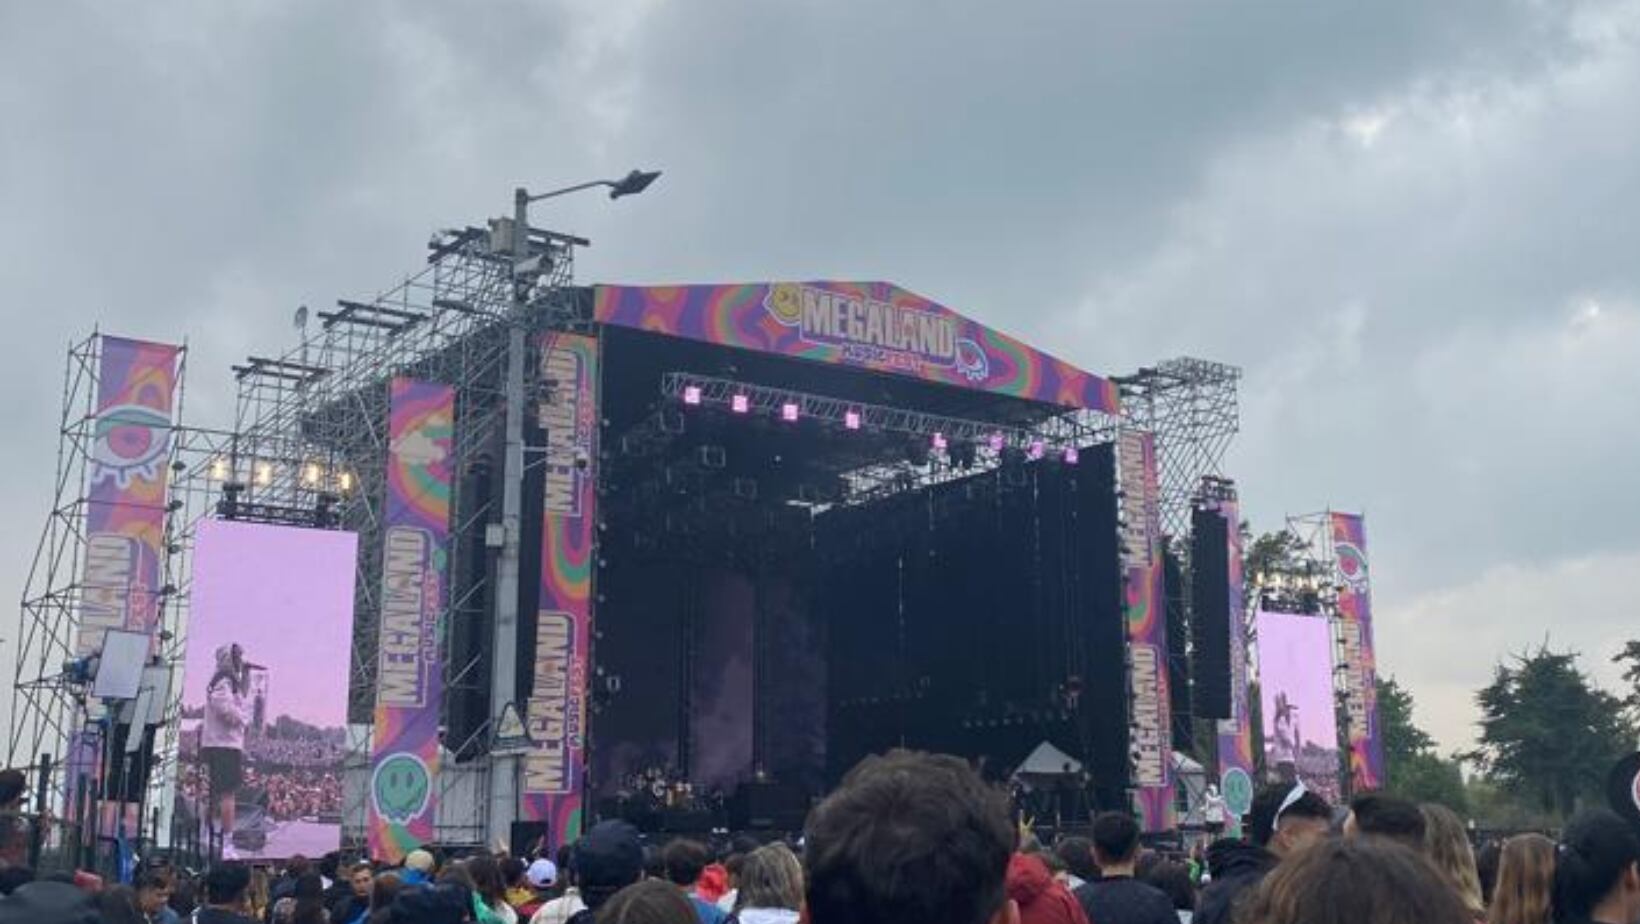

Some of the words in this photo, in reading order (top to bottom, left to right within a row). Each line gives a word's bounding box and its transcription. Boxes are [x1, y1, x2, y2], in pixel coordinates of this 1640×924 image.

[803, 291, 954, 357] MEGALAND
[381, 531, 424, 702] MEGALAND
[527, 615, 568, 790] MEGALAND
[1131, 648, 1162, 783] MEGALAND
